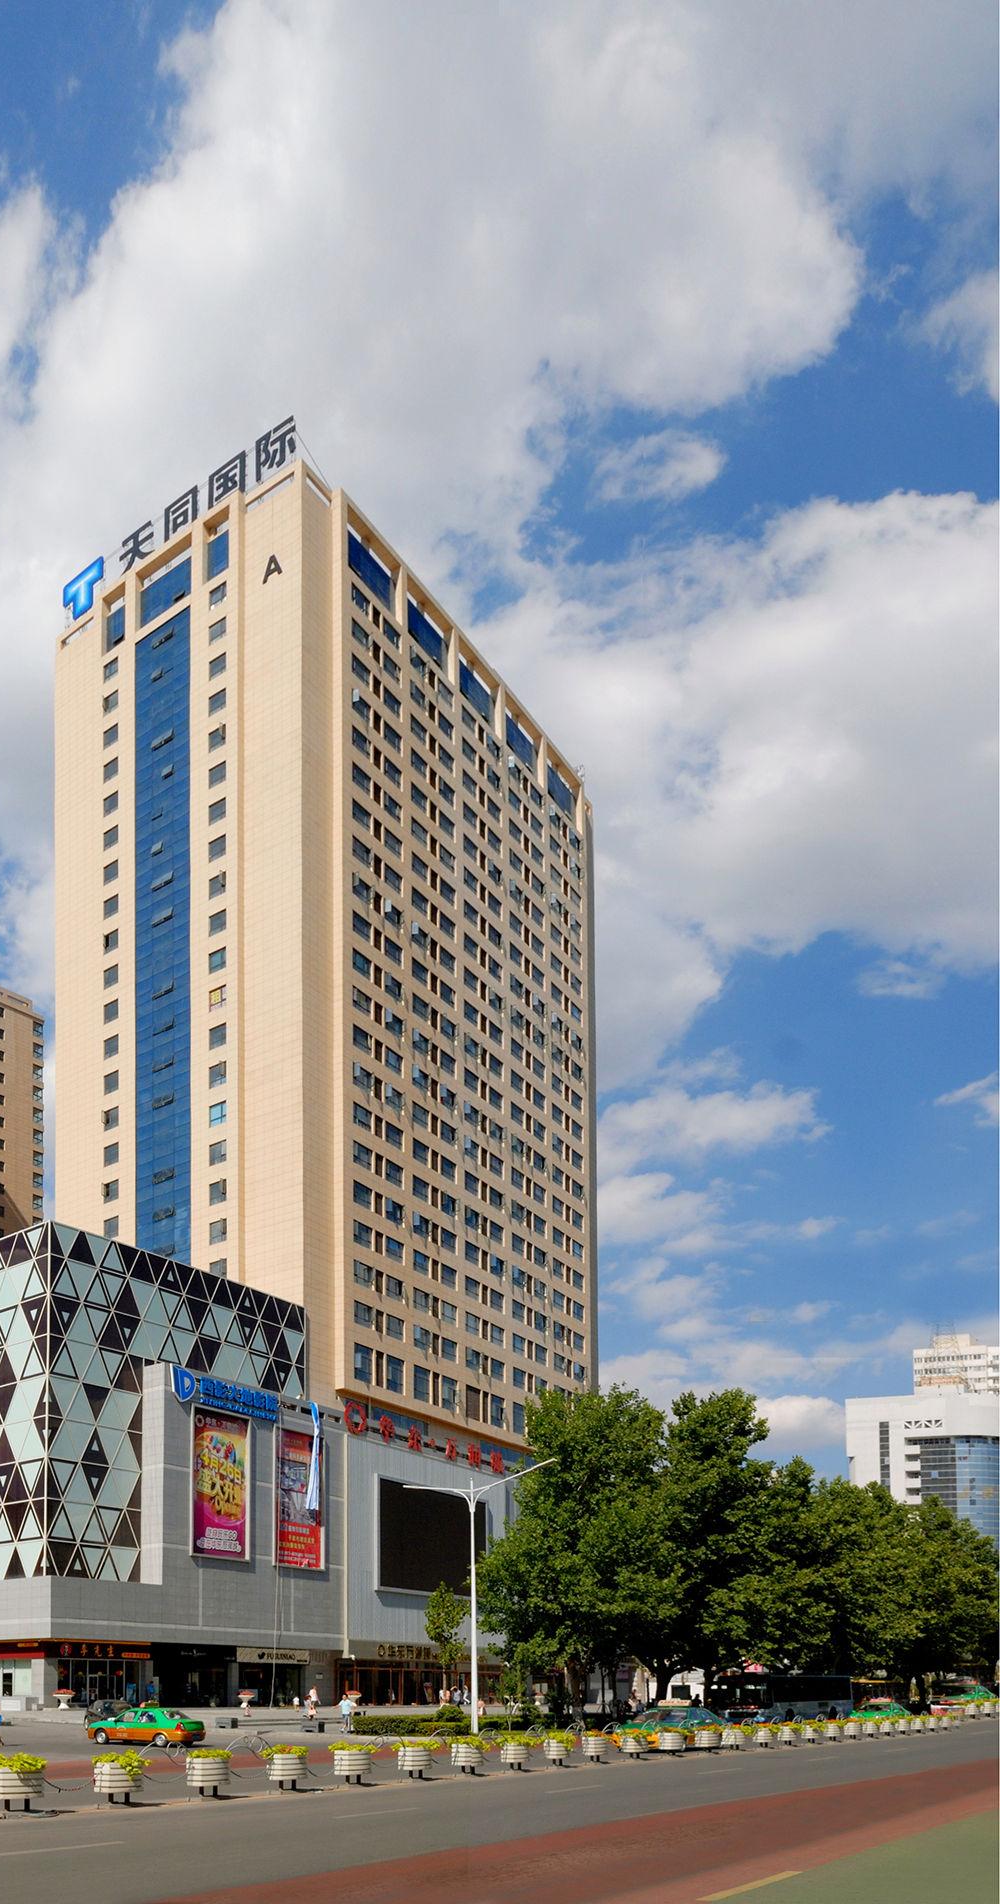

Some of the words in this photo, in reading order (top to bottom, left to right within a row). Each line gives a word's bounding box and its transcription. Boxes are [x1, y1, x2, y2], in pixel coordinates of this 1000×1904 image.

[119, 415, 296, 576] 天同国际
[262, 554, 283, 584] A
